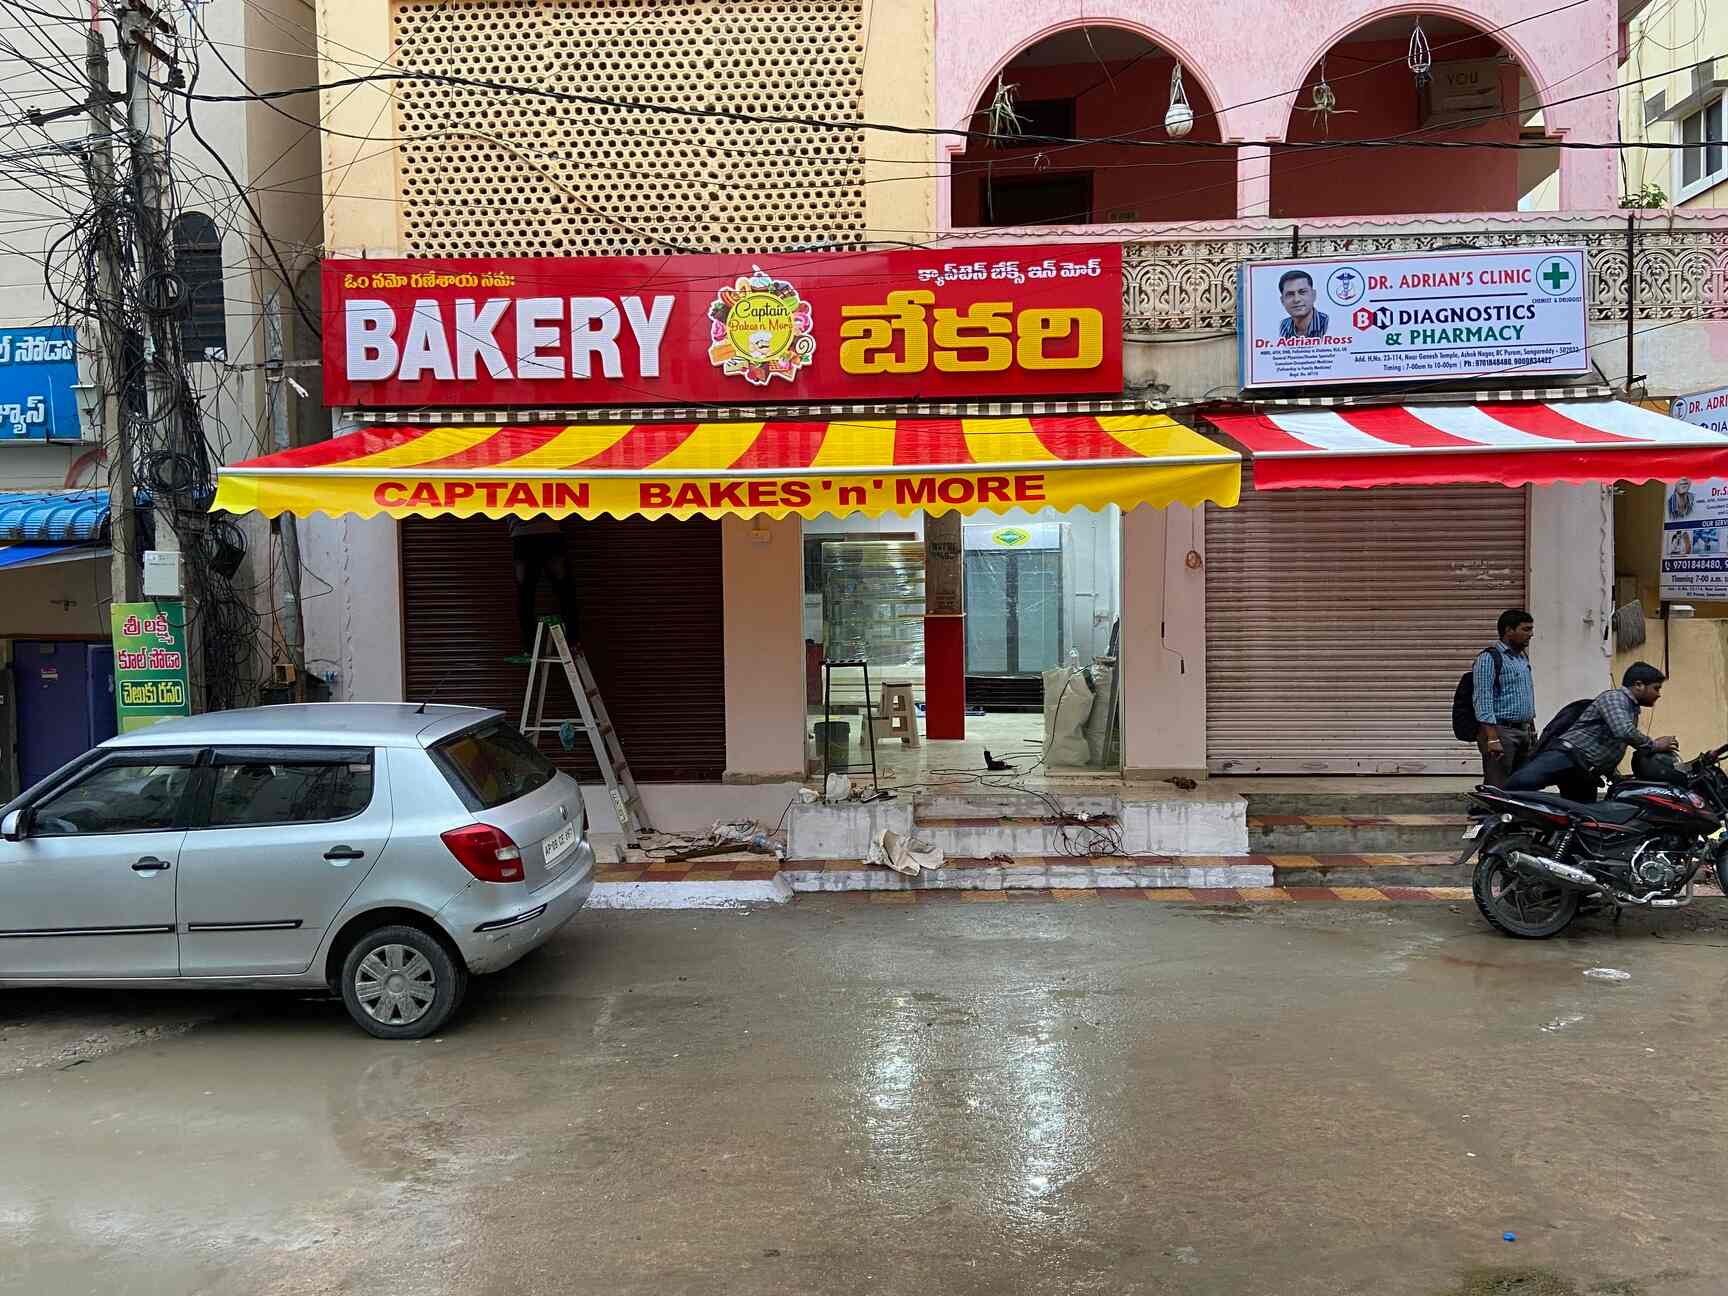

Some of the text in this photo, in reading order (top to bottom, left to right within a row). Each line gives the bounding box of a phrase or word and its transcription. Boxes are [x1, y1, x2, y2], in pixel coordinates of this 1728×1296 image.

[344, 273, 369, 288] ఓం
[372, 273, 408, 288] నమో
[411, 270, 478, 288] గణేశాయ
[1368, 269, 1531, 290] DR. ADRIAN'S CLINIC
[736, 300, 788, 322] Captain
[1399, 305, 1536, 325] DIAGNOSTICS
[345, 296, 675, 382] BAKERY
[840, 290, 1104, 375] బేకరి
[1255, 335, 1353, 348] Dr. Adrian Ross
[1385, 325, 1525, 346] & PHARMACY
[1689, 401, 1703, 414] DR.
[374, 482, 590, 509] CAPTAIN
[639, 481, 812, 509] BAKES
[896, 474, 1046, 505] MORE
[123, 616, 141, 636] శ్రీ
[118, 647, 182, 669] కూల్ సోడా
